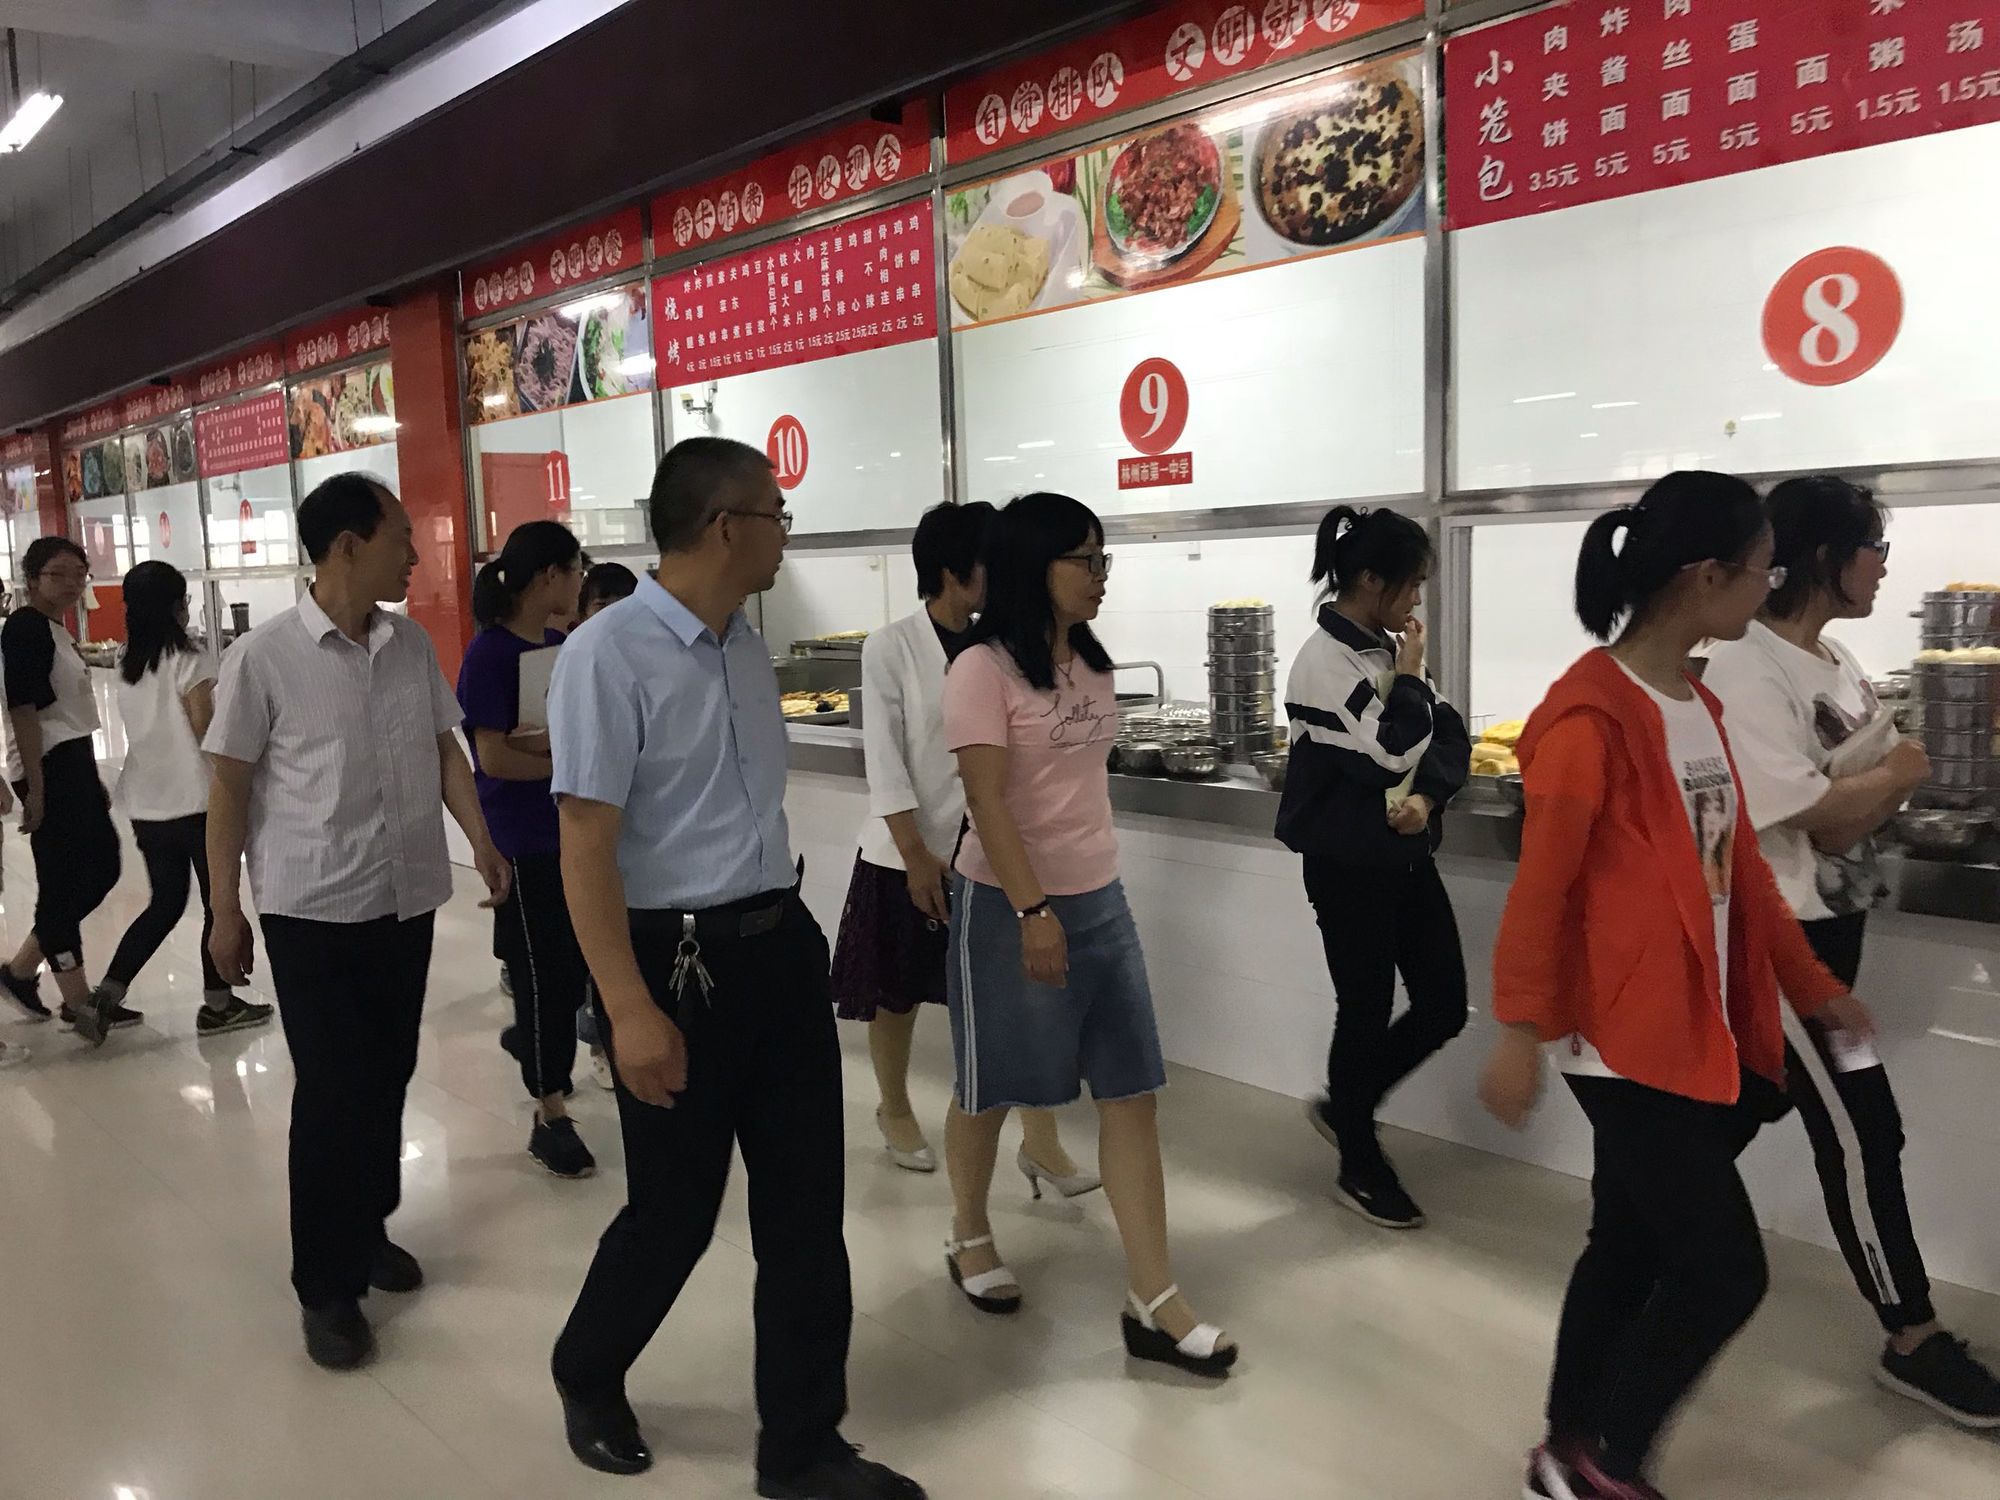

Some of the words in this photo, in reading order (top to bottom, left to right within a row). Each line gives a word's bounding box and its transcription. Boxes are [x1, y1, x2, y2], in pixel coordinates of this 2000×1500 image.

[1727, 19, 1759, 105] 蛋面
[1947, 19, 1983, 53] 汤
[976, 53, 1124, 145] 自觉排队
[1541, 25, 1569, 147] 肉夹饼
[1600, 7, 1629, 135] 炸酱面
[1795, 54, 1829, 88] 面
[1856, 88, 1921, 120] 1.5元
[1938, 70, 2000, 104] 1.5元
[1475, 50, 1513, 201] 小笼包
[1653, 138, 1690, 164] 5元
[1720, 122, 1760, 149] 5元
[1791, 105, 1832, 134] 5元
[788, 134, 901, 208] 拒收现金
[1529, 163, 1579, 191] 3.5元
[1595, 152, 1629, 176] 5元
[820, 241, 831, 318] 芝麻球四个
[848, 233, 860, 311] 鸡心
[863, 228, 875, 308] 甜不辣
[879, 224, 889, 305] 骨肉相连
[665, 297, 680, 365] 烧烤
[1799, 273, 1860, 366] 8
[1139, 373, 1169, 439] 9
[547, 461, 567, 501] 11
[774, 426, 801, 478] 10
